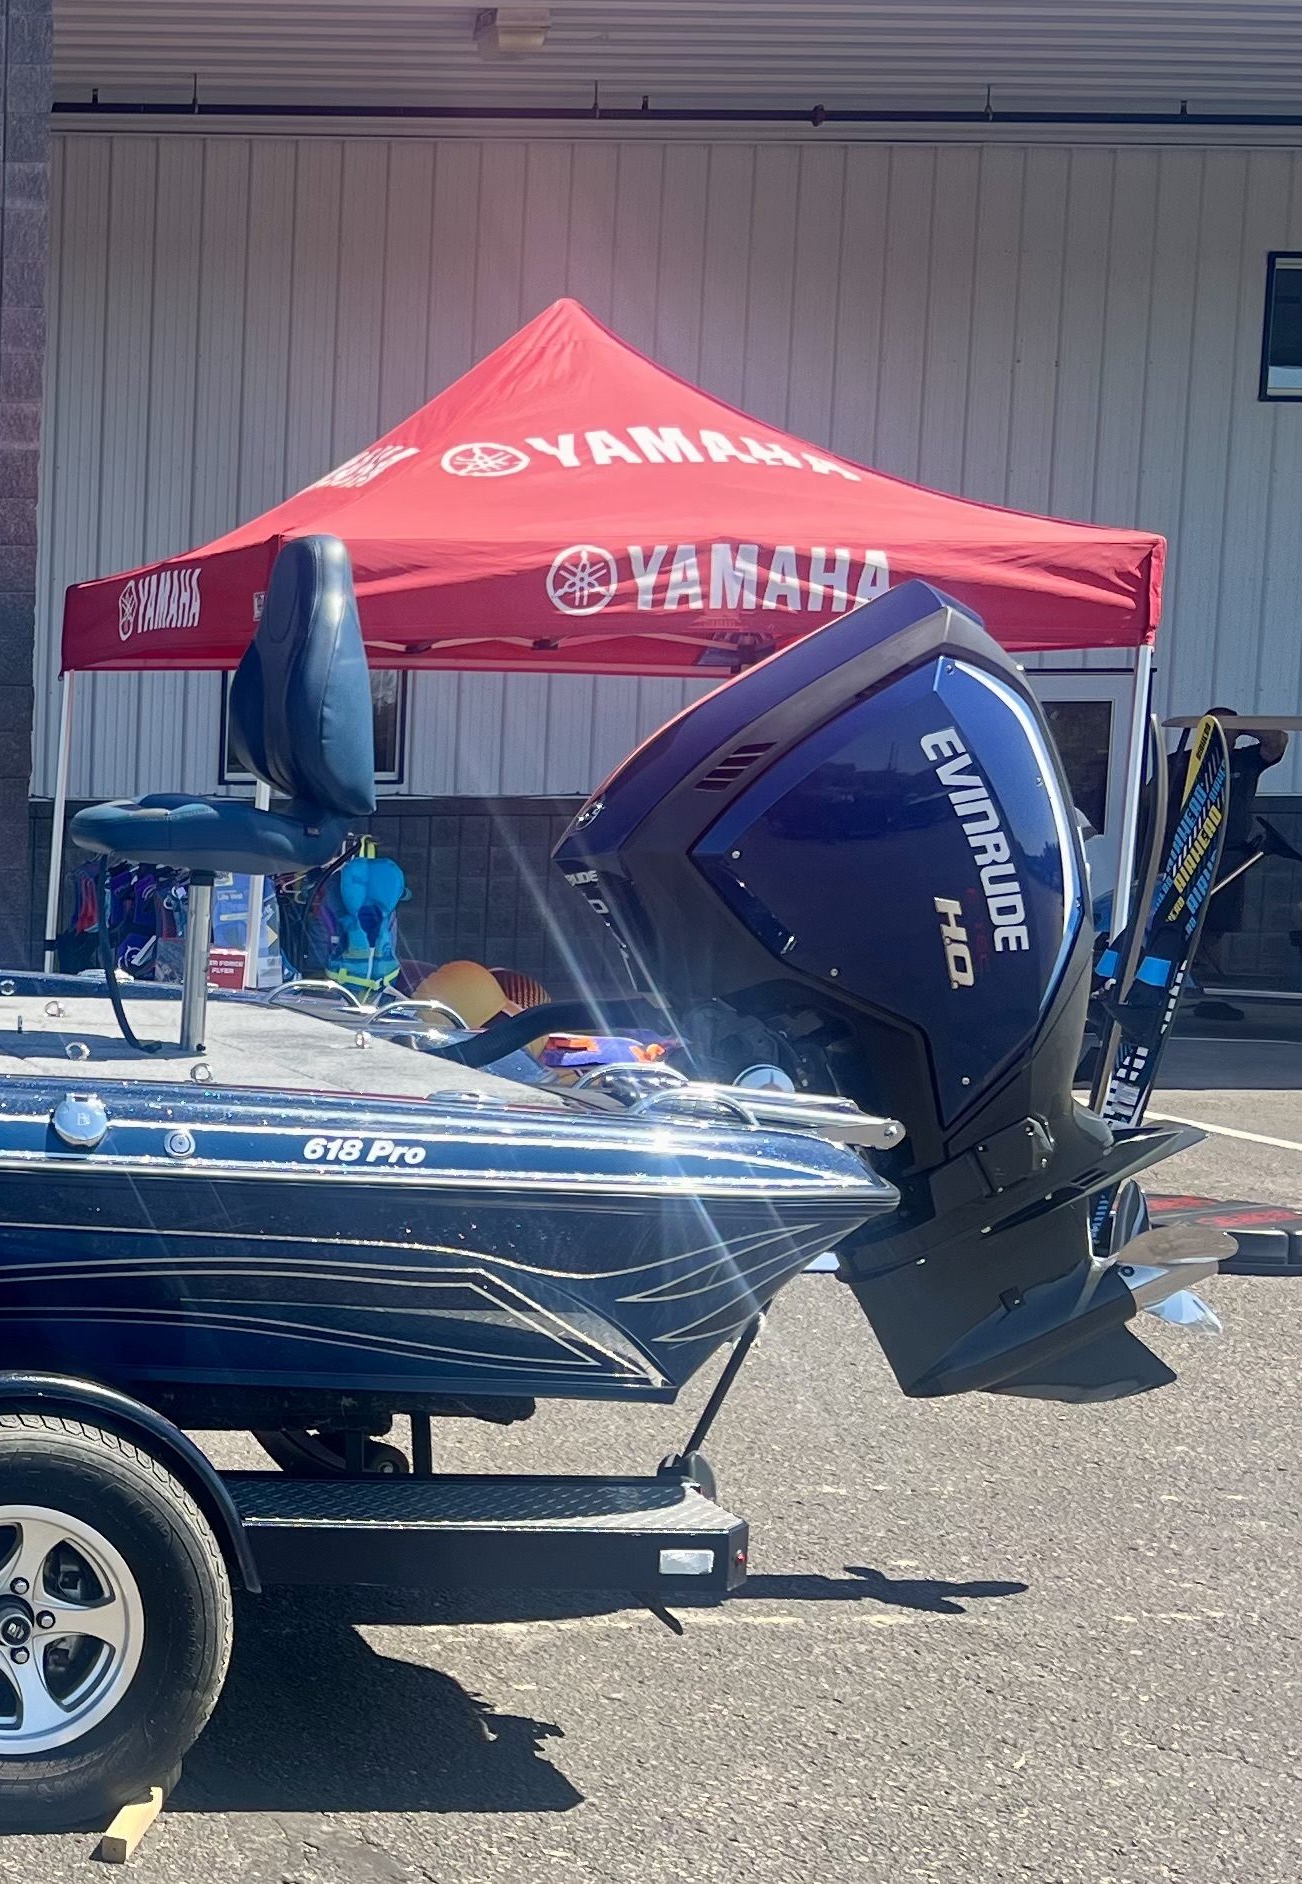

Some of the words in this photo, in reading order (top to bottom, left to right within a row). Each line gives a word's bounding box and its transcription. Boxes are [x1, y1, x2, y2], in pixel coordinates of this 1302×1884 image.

[525, 425, 862, 482] YAMAHA
[137, 567, 202, 634] YAMAHA
[627, 542, 891, 613] YAMAHA
[919, 725, 1030, 952] EVINRUDE
[1172, 803, 1223, 895] AIRHEAD
[211, 967, 234, 975] FLYER
[218, 960, 245, 968] FORCE
[303, 1137, 363, 1162] 618
[365, 1139, 427, 1165] Pro
